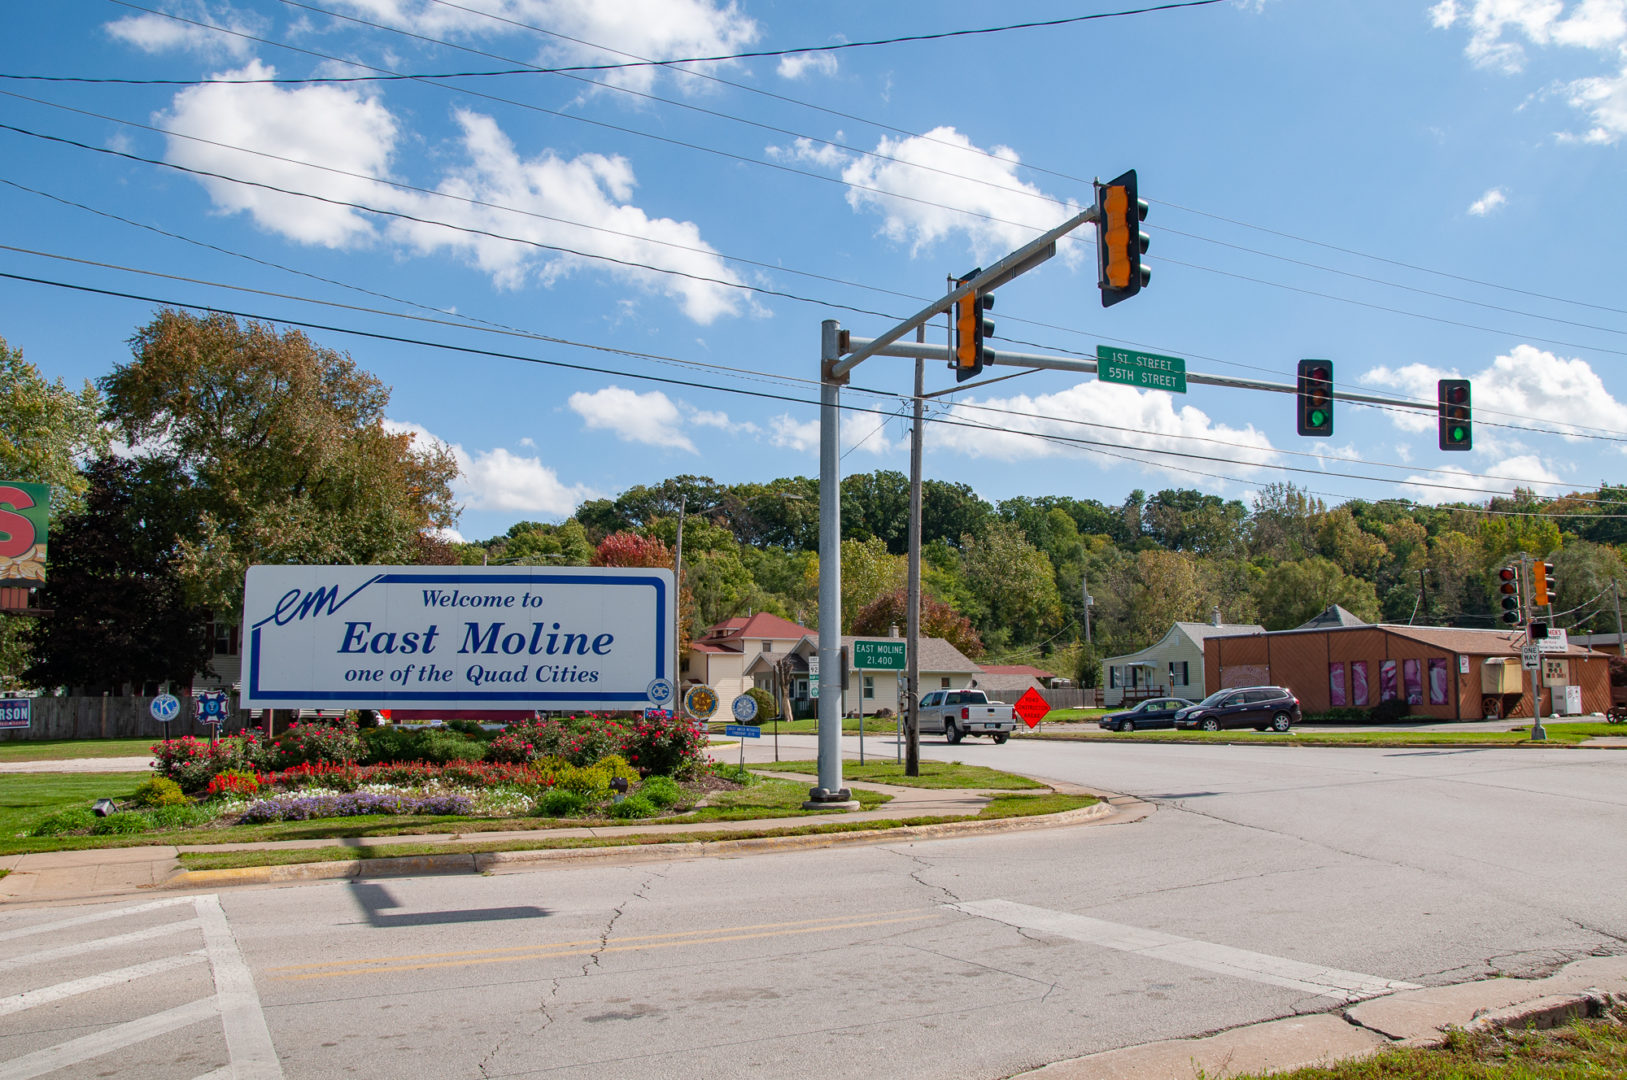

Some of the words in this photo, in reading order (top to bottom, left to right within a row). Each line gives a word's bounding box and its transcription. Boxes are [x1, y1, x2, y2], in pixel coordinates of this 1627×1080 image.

[1112, 352, 1128, 364] 1ST
[1136, 356, 1172, 370] STREET
[1108, 367, 1134, 381] 55TH
[1141, 372, 1177, 387] STREET
[422, 590, 515, 608] Welcome
[521, 592, 544, 608] to
[337, 621, 440, 655] East
[457, 622, 615, 656] Moline
[856, 644, 874, 653] EAST
[877, 645, 904, 654] MOLINE
[344, 668, 384, 682] one
[390, 664, 415, 686] of
[418, 664, 454, 682] the
[466, 664, 529, 686] Quad
[535, 664, 600, 683] Cities
